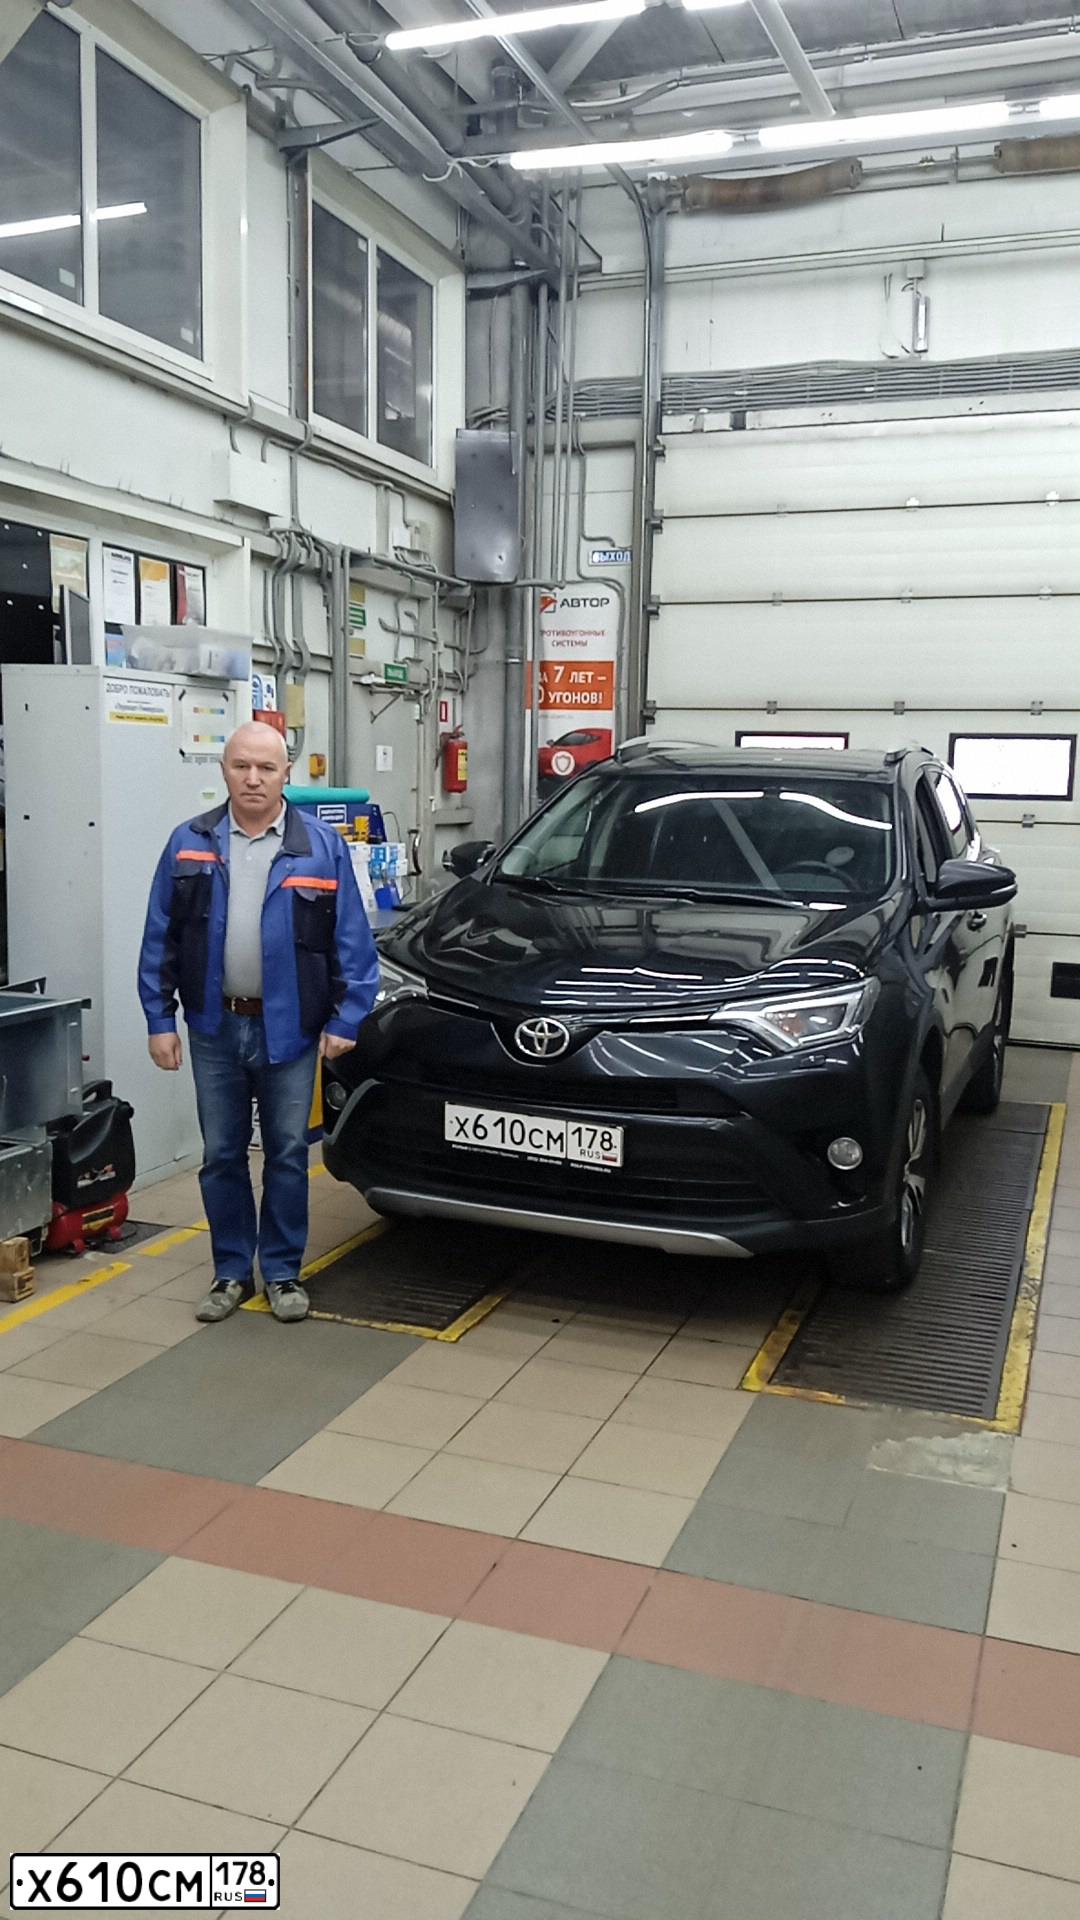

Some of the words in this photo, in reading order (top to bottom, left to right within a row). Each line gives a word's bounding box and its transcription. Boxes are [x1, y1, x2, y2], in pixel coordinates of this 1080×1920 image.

[560, 597, 610, 608] АВТОР
[540, 630, 606, 638] РОТИВОУГОННЫЕ
[551, 640, 588, 648] СИСТЕМЫ
[553, 665, 565, 684] 7
[569, 671, 595, 684] ЛЕТ
[548, 691, 603, 704] УГОНОВ!
[571, 1127, 613, 1152] 178
[579, 1148, 601, 1160] RUS
